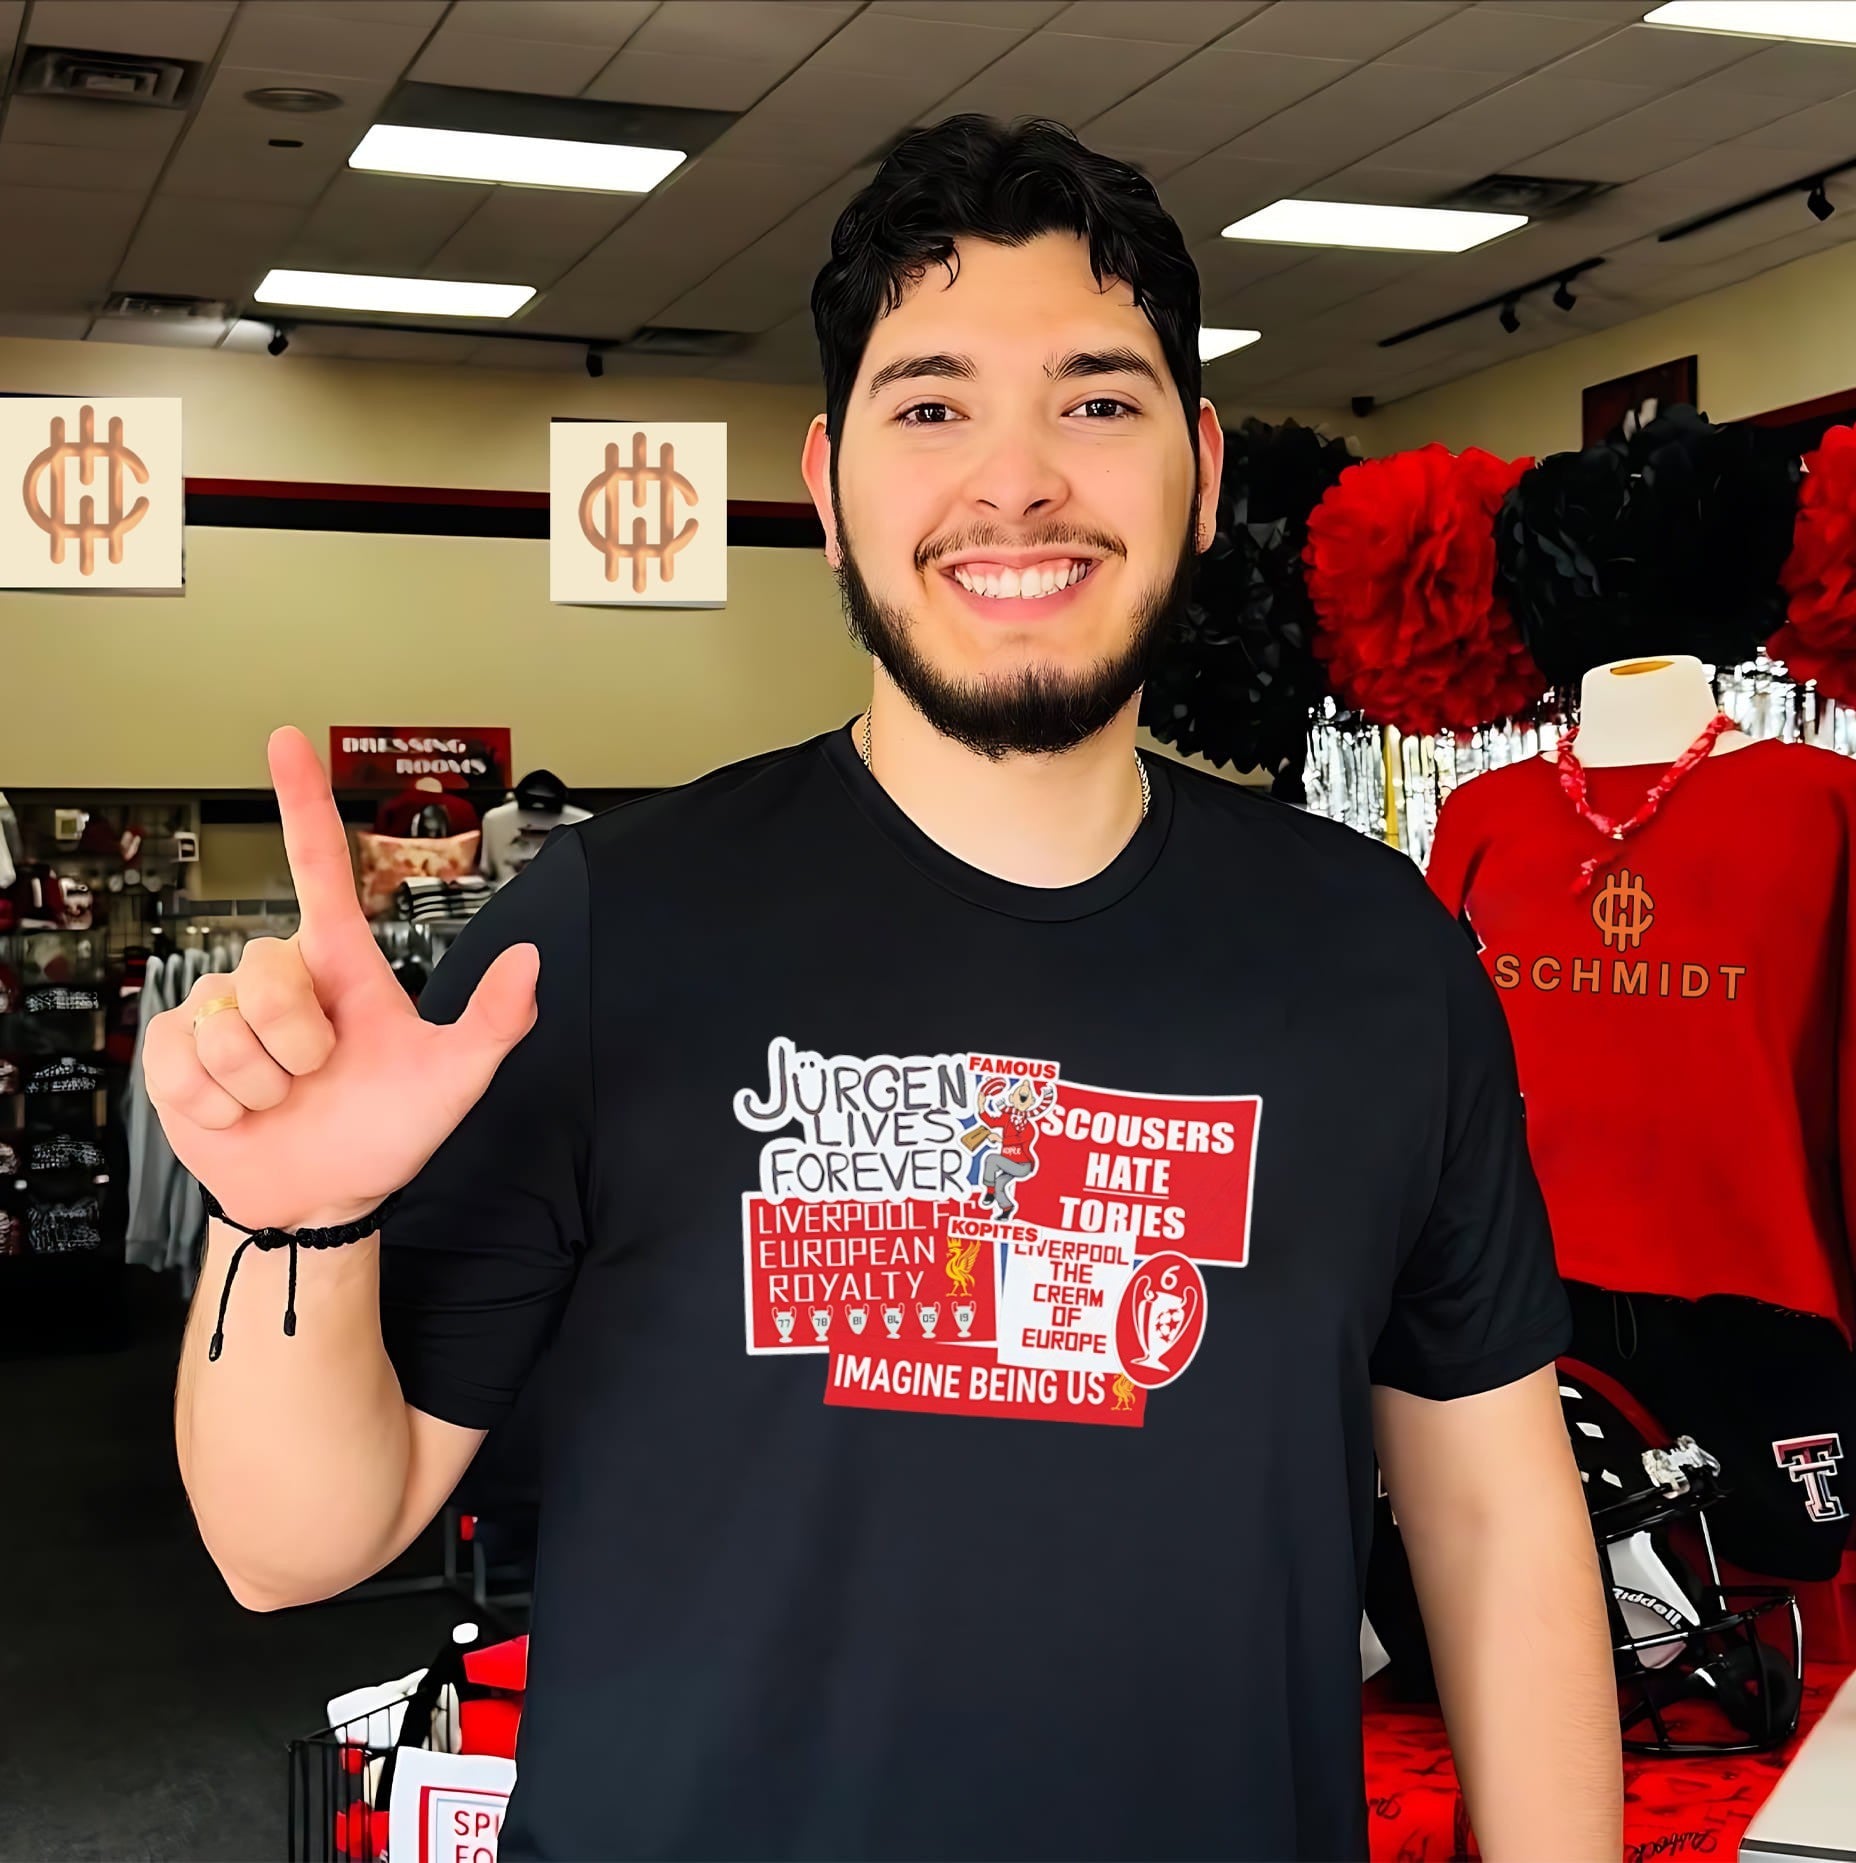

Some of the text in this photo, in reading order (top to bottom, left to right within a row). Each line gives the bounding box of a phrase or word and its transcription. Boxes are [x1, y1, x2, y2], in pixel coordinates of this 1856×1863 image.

[396, 758, 487, 775] ROOMS
[1494, 953, 1748, 1001] SCHMIDT
[968, 1056, 1057, 1080] FAMOUS
[813, 1109, 955, 1147] LIVES
[1040, 1104, 1235, 1155] SCOUSERS
[771, 1148, 965, 1195] FOREVER
[1084, 1151, 1171, 1196] HATE
[757, 1201, 927, 1234] LIVERPOOL
[950, 1219, 1039, 1243] KOPITES
[1059, 1195, 1186, 1240] TORIES
[759, 1235, 935, 1269] EUROPEAN
[1013, 1239, 1129, 1266] LIVERPOOL
[768, 1270, 925, 1304] ROYALTY
[1050, 1260, 1093, 1284] THE
[1160, 1264, 1181, 1291] 6
[1033, 1283, 1104, 1308] CREAM
[777, 1318, 791, 1328] 77
[814, 1317, 828, 1327] 78
[1051, 1306, 1082, 1327] OF
[1021, 1328, 1107, 1354] EUROPE
[833, 1353, 1106, 1406] IMAGINE BEING US
